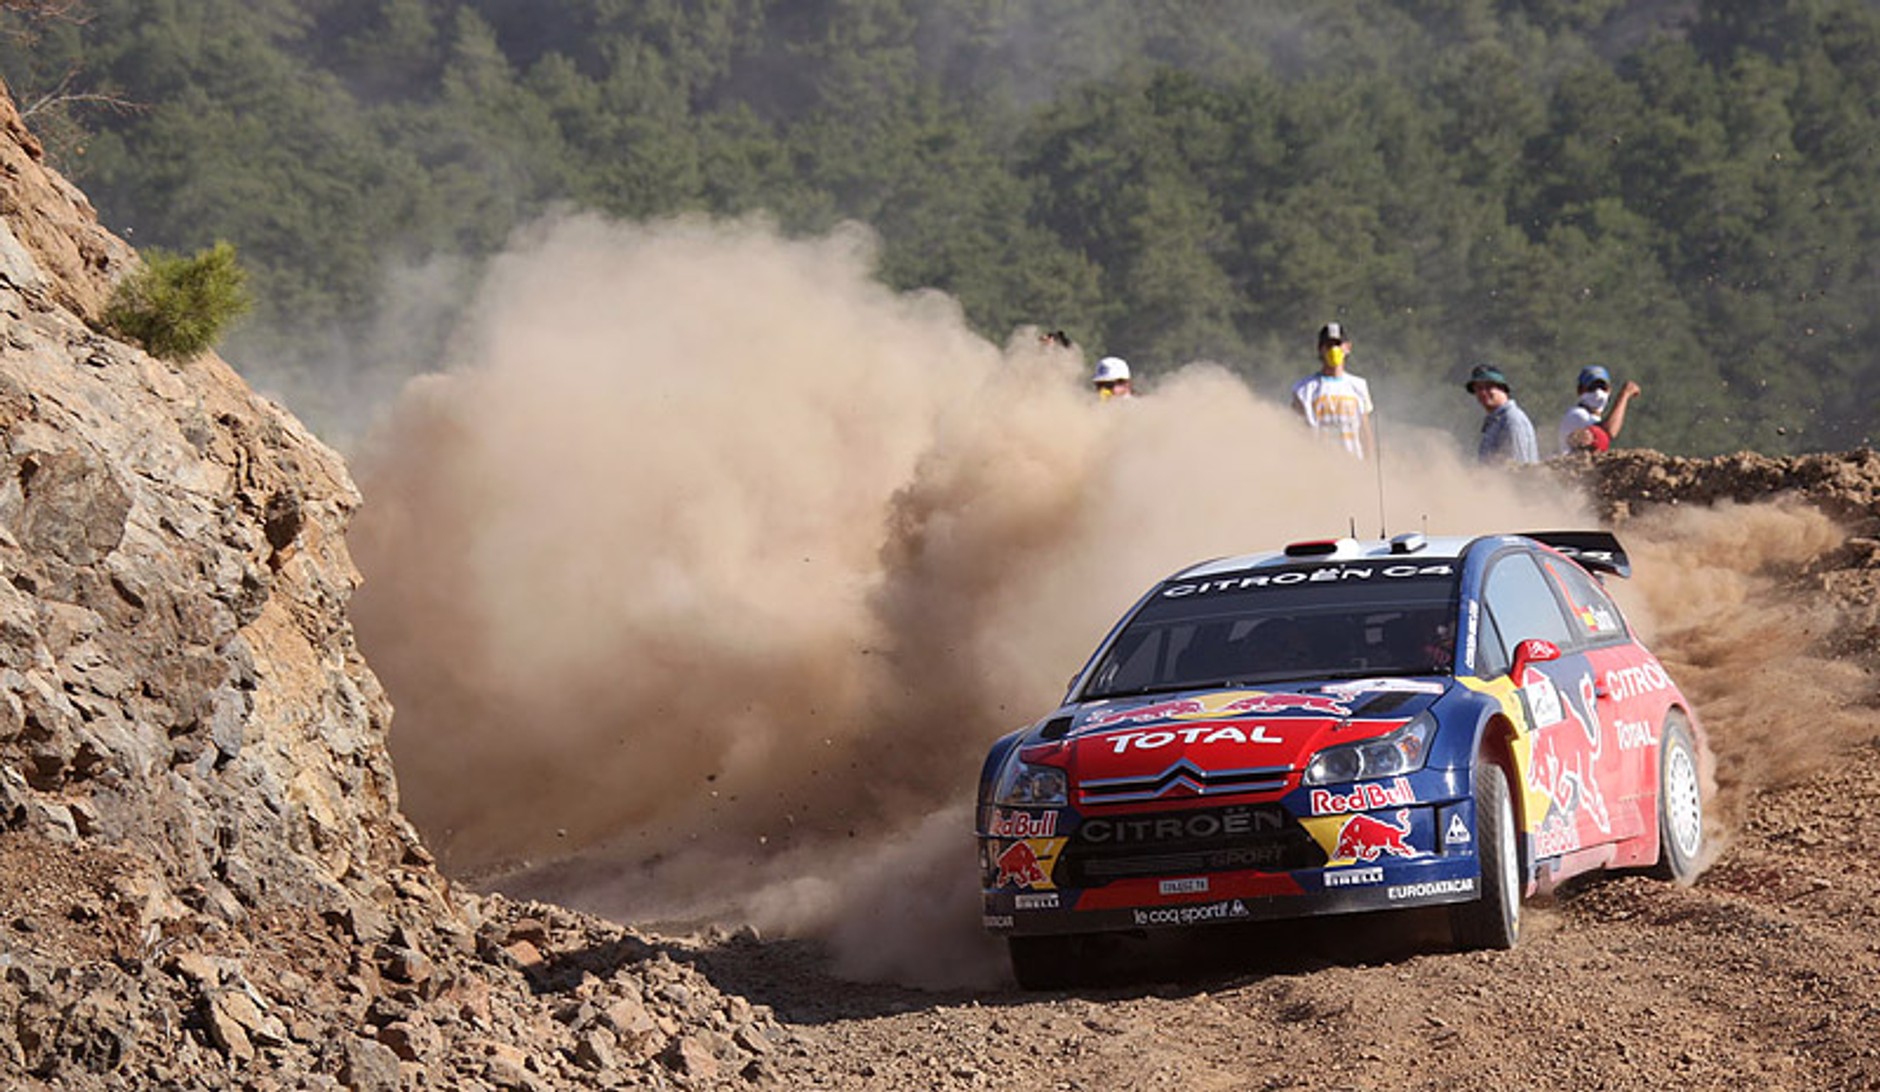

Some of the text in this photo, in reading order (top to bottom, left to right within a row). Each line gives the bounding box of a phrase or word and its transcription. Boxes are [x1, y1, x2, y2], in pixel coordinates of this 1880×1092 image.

[1163, 564, 1453, 598] CITROËN C4
[1107, 726, 1283, 753] TOTAL
[1613, 720, 1658, 751] TOTAL
[1311, 777, 1414, 815] Red Bull
[1081, 808, 1284, 841] CITROËN
[1324, 868, 1383, 886] PIRELLI
[1388, 878, 1474, 899] EURODATACAR
[1134, 903, 1227, 925] le coq sportif
